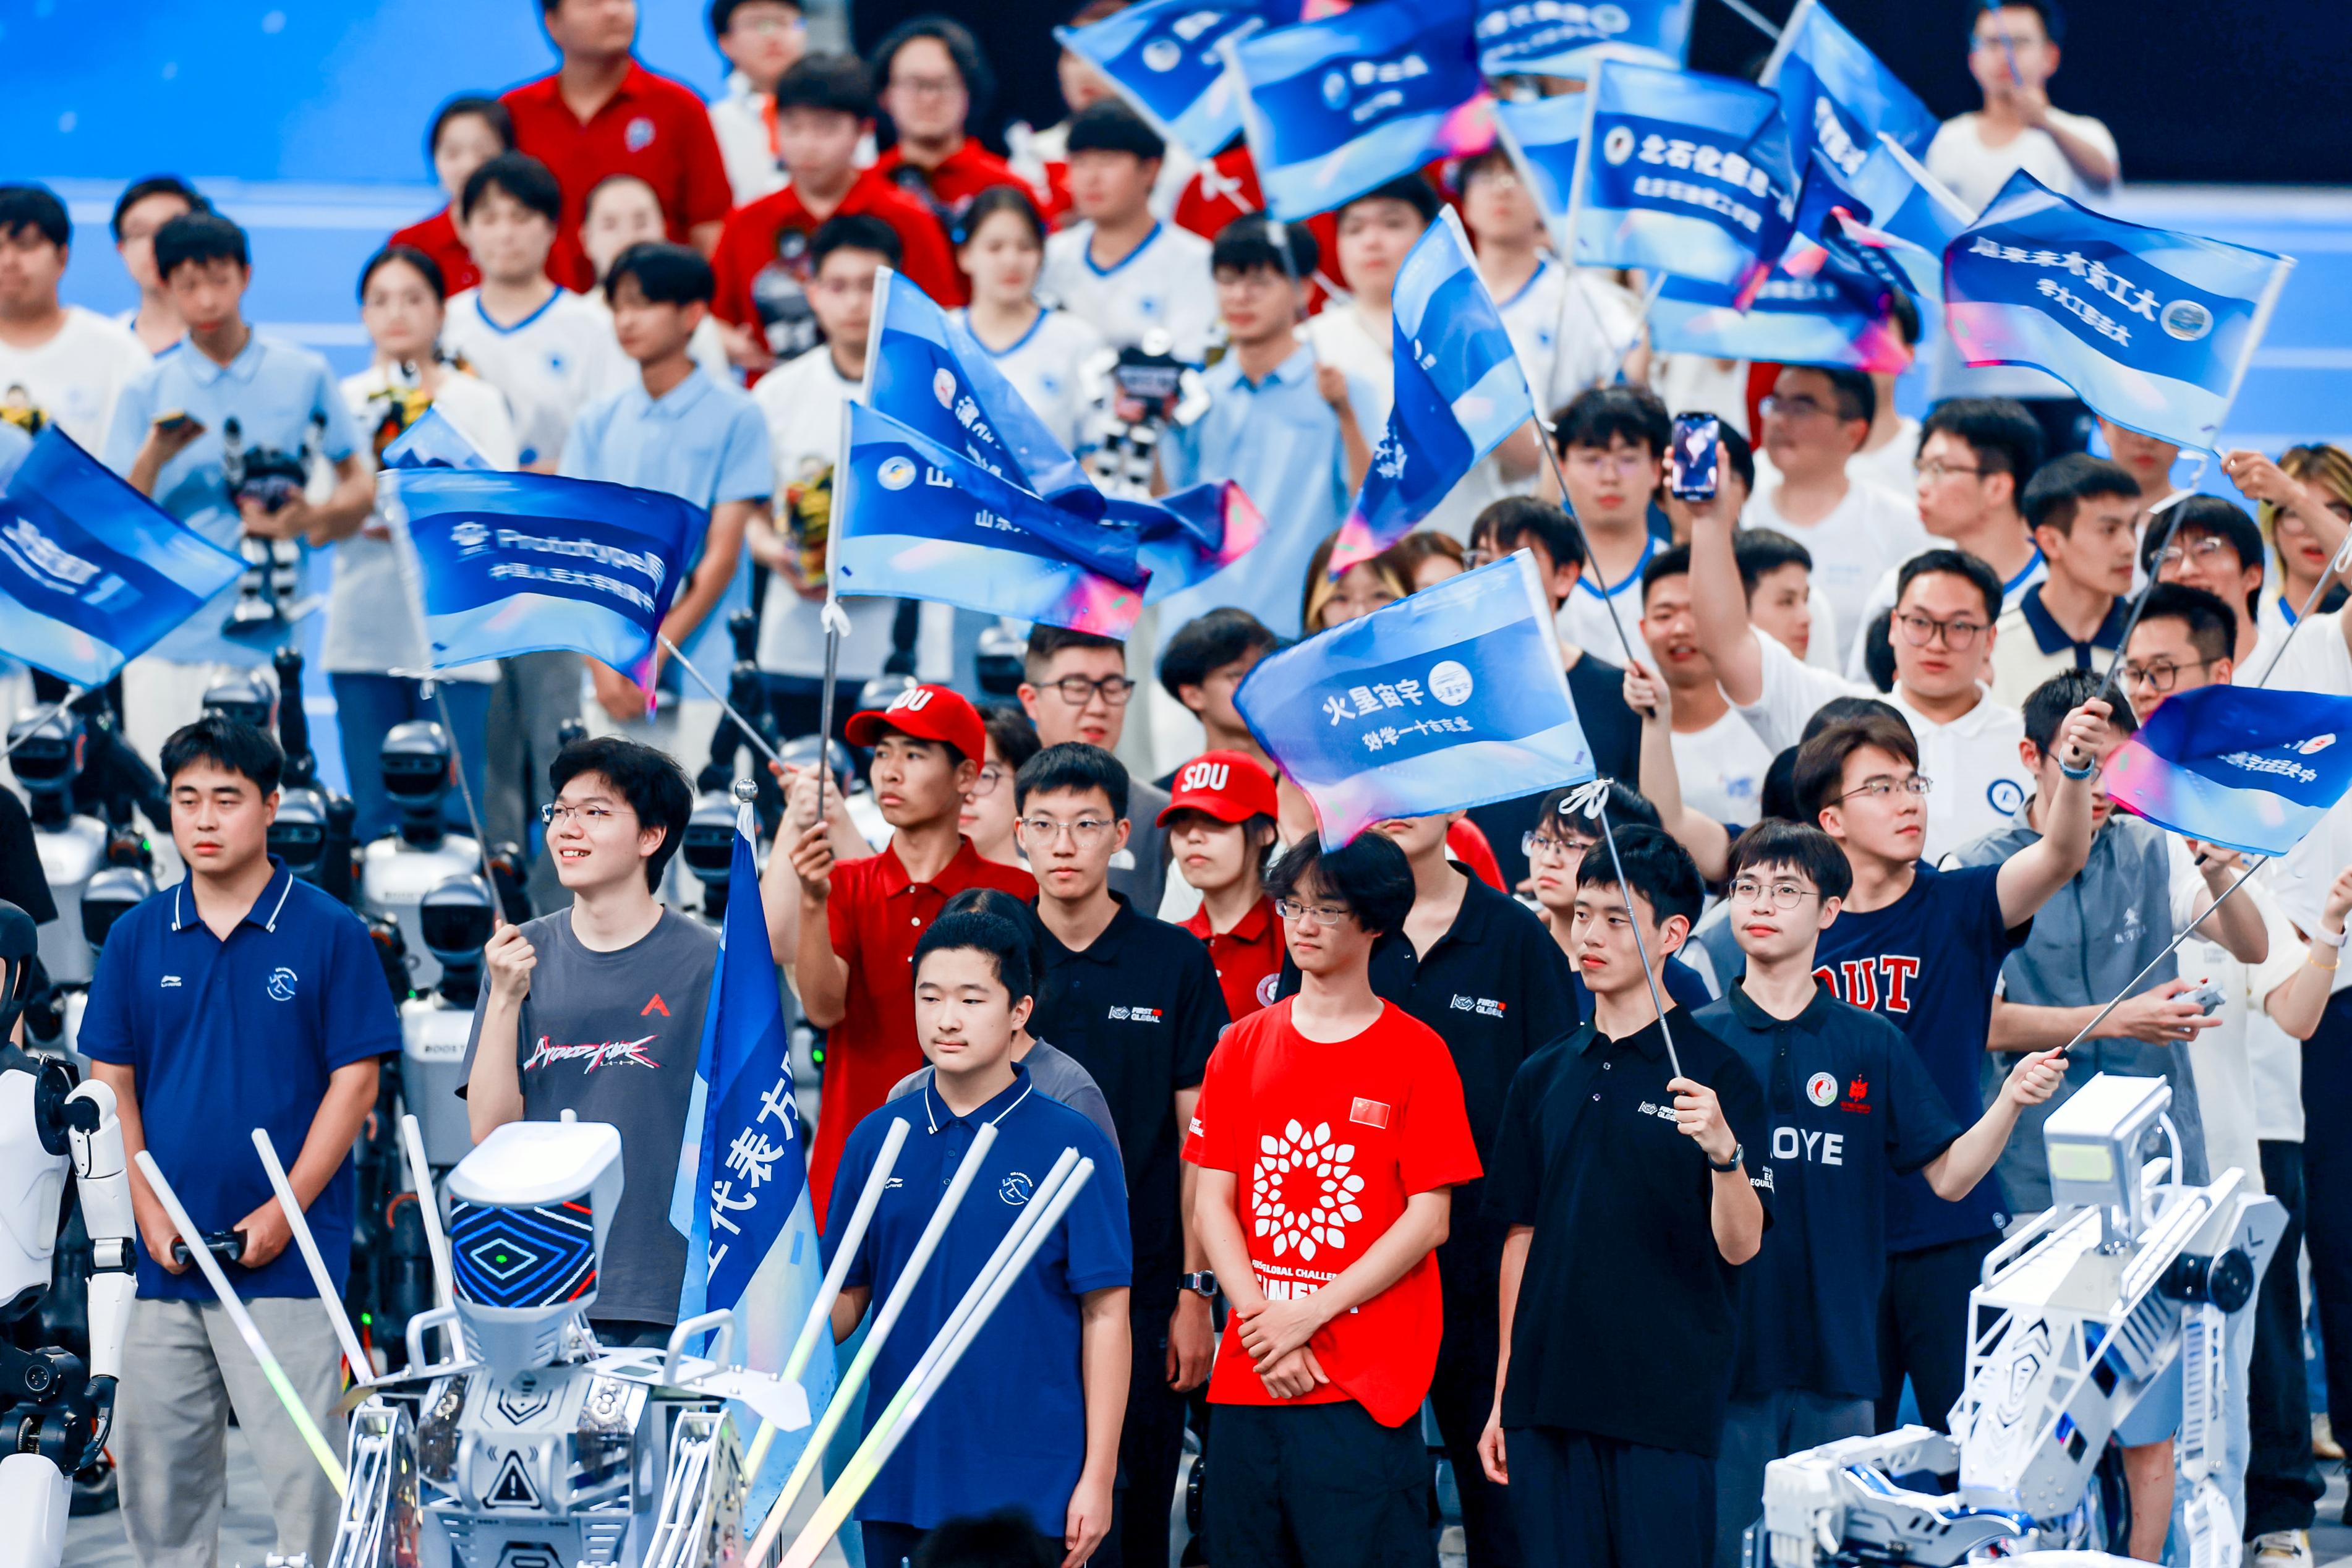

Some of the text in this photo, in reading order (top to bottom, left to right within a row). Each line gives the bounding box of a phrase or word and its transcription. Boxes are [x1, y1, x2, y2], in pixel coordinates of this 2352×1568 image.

[1181, 762, 1230, 793] SDU
[1131, 1013, 1161, 1023] GLOBAL
[1658, 1111, 1682, 1124] GLOB
[1770, 1127, 1844, 1165] OYE
